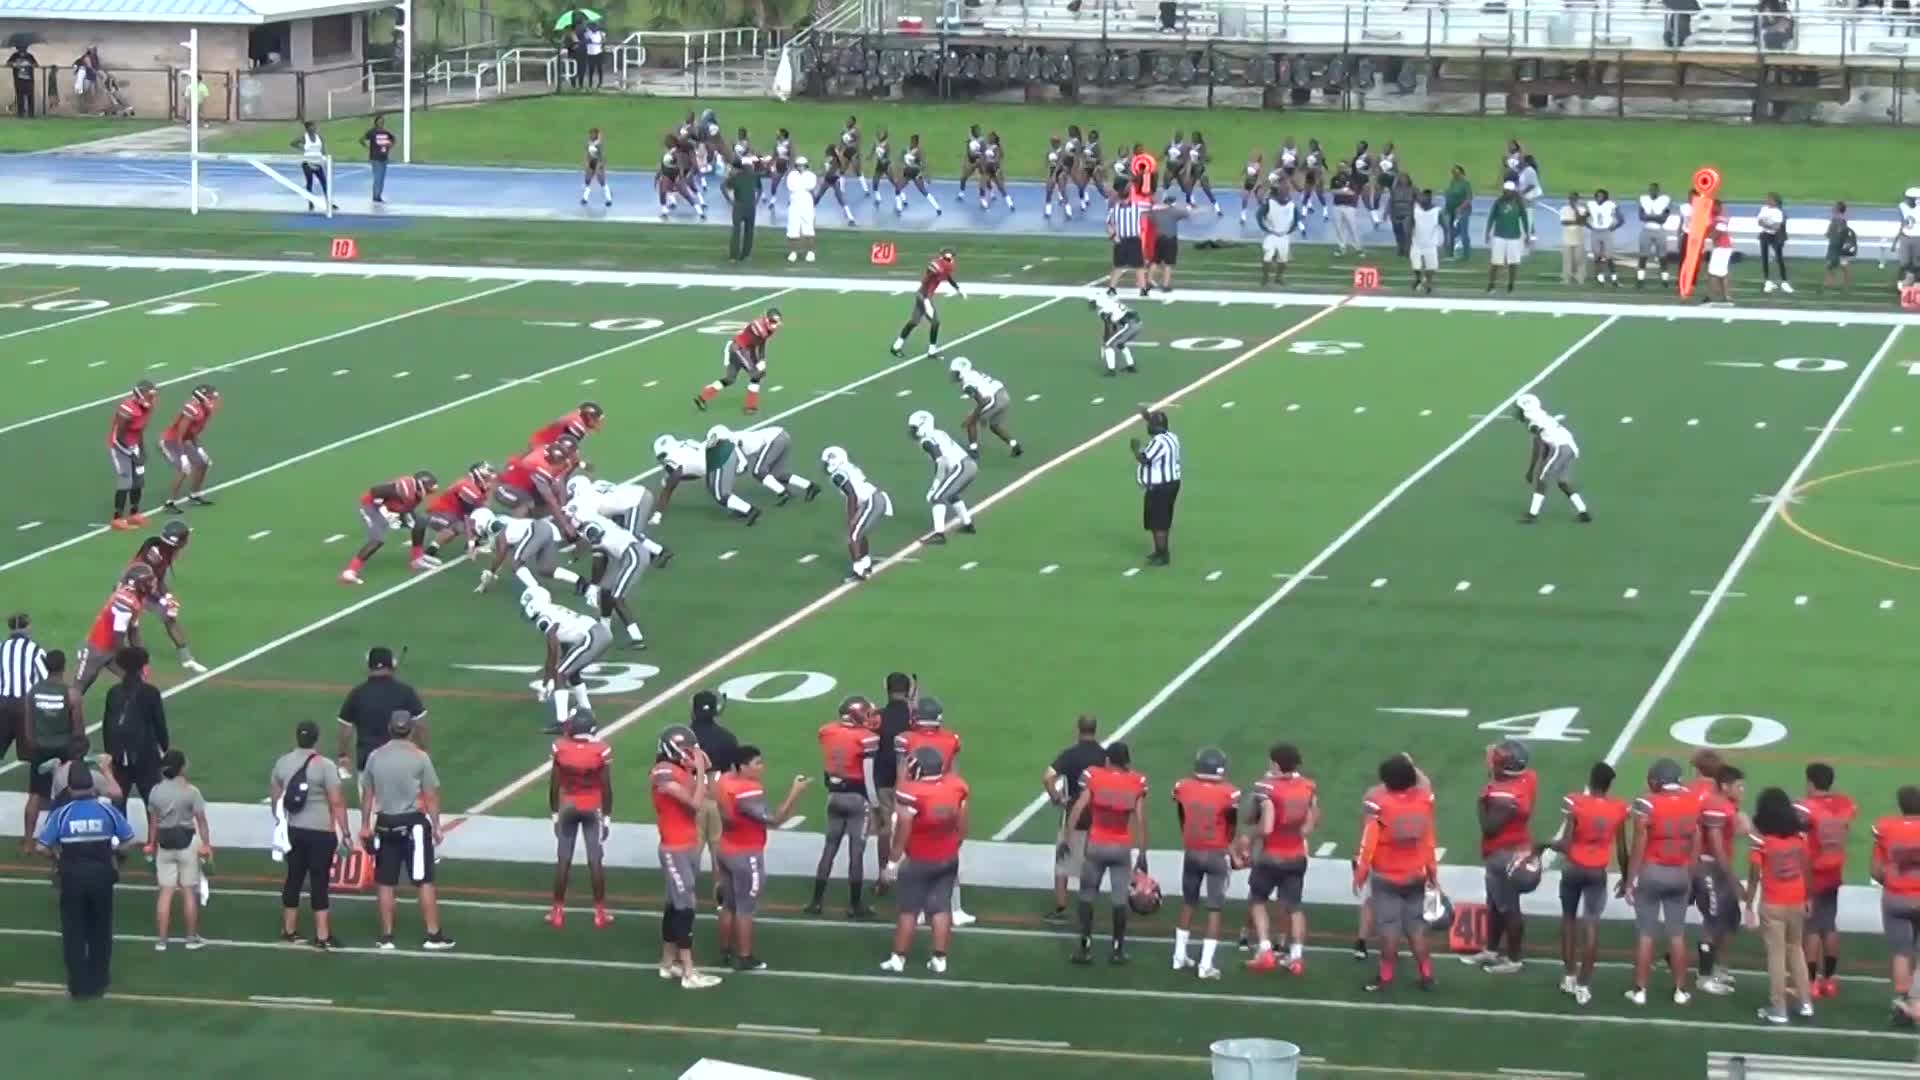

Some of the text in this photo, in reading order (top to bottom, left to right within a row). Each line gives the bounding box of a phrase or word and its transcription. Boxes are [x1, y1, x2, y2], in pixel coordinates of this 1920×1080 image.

[335, 240, 350, 257] 10
[873, 245, 891, 260] 20
[1355, 271, 1374, 289] 30
[1455, 907, 1489, 945] 40
